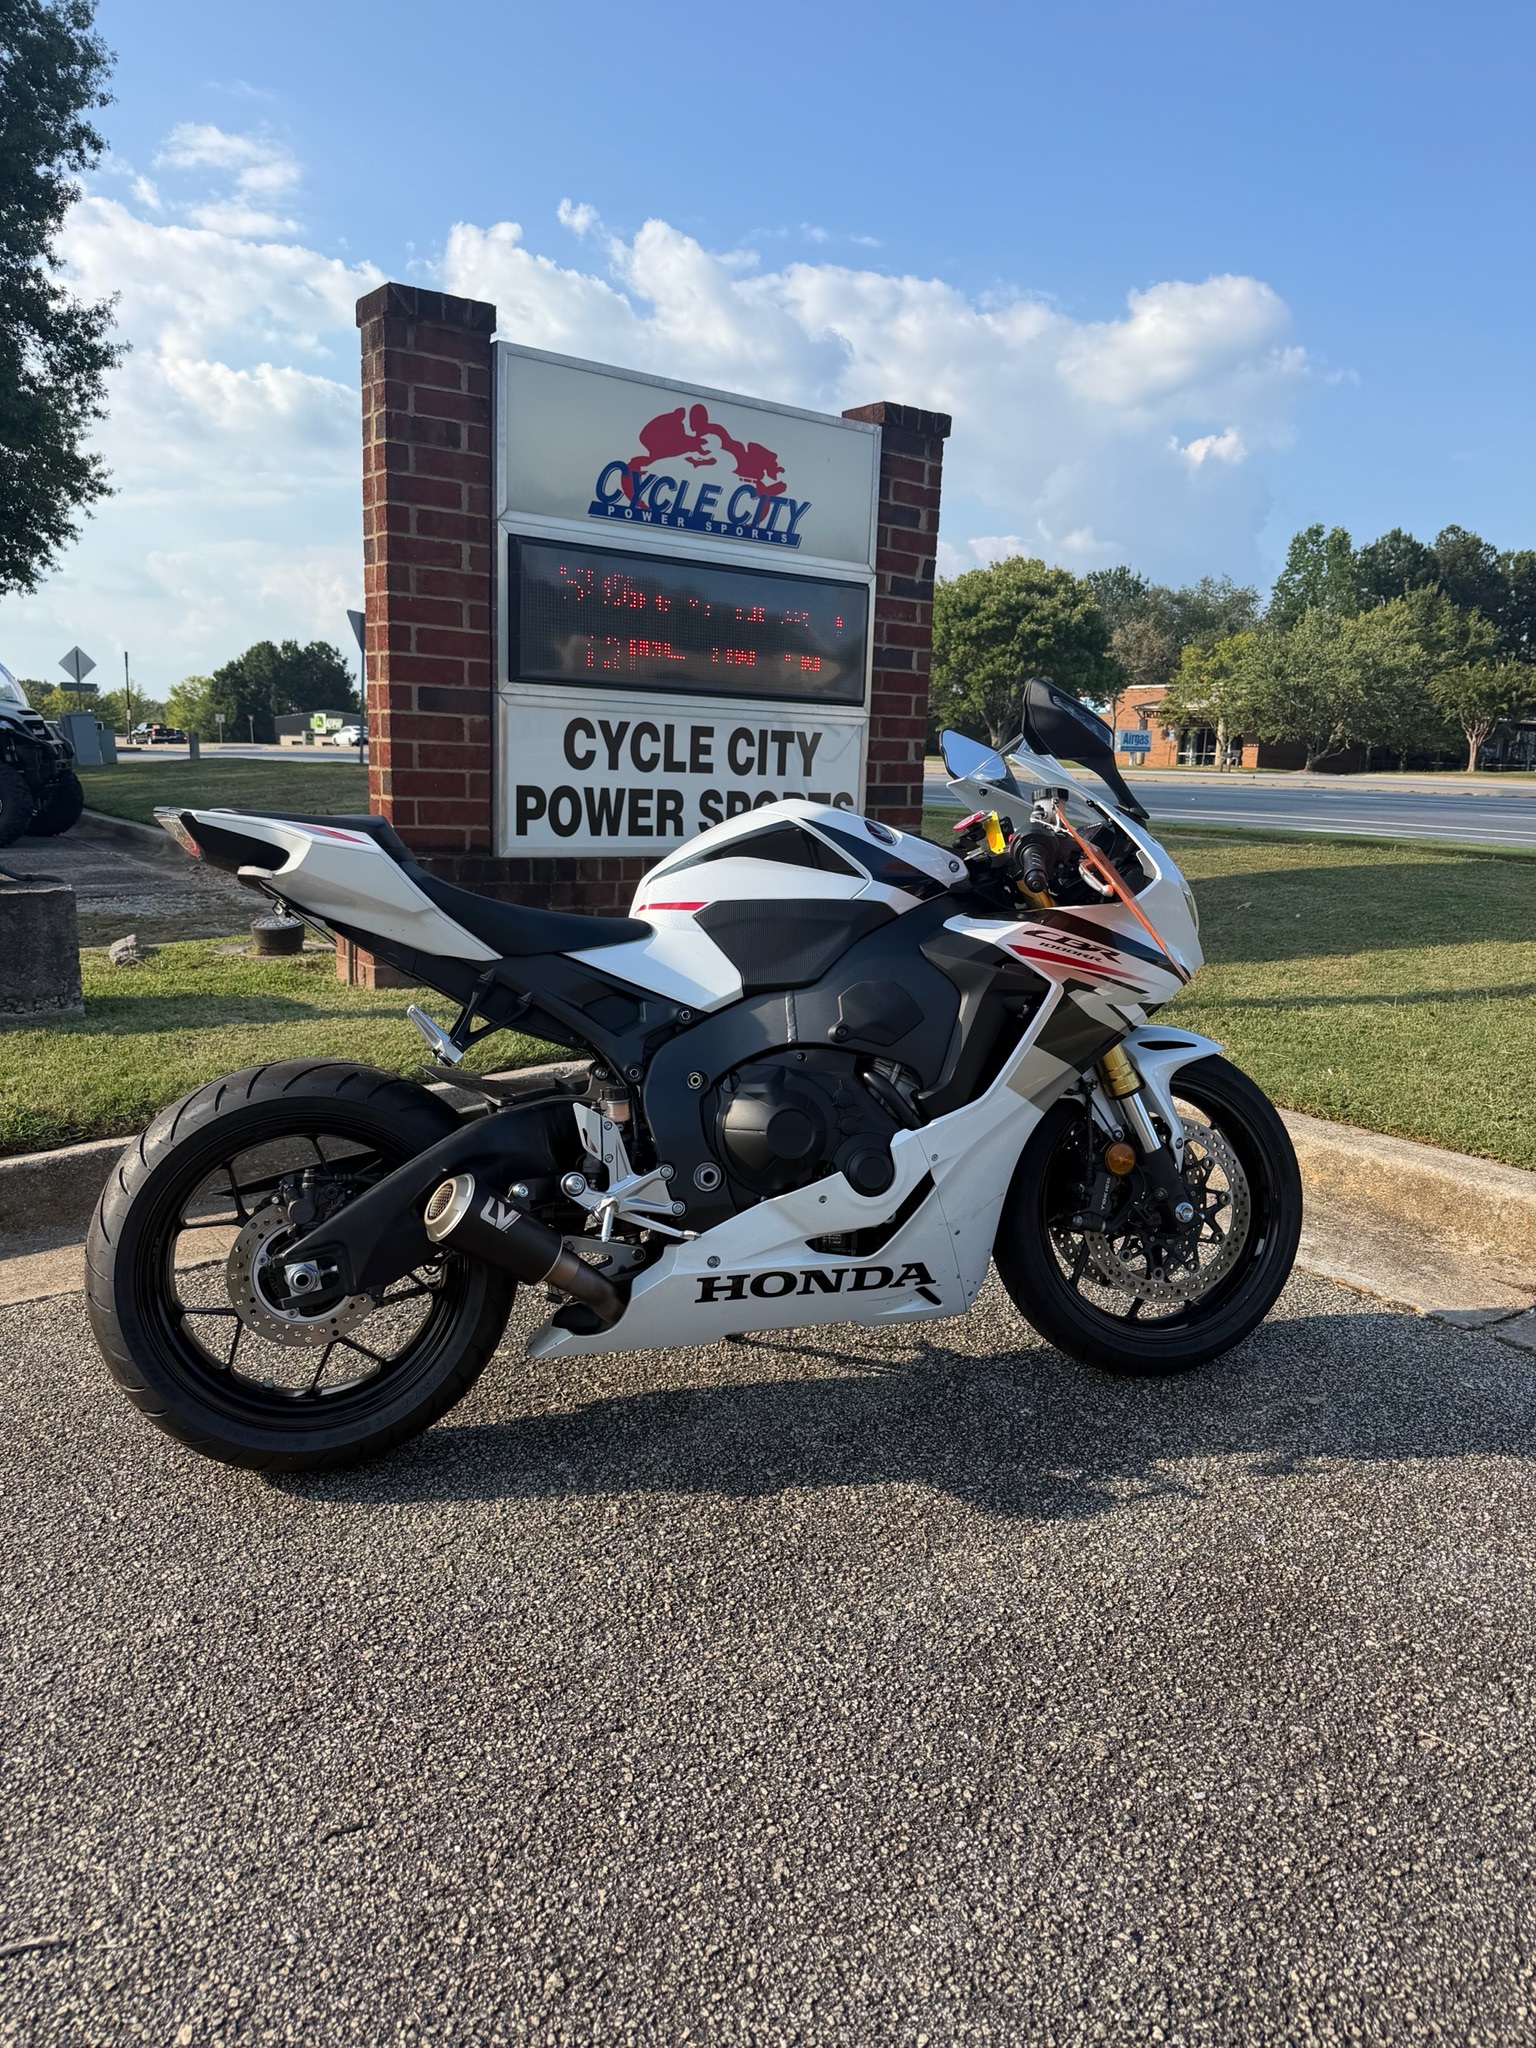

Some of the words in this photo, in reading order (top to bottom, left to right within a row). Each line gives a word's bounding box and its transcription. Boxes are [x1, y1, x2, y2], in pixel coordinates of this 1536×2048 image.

[596, 461, 722, 517] CYCLE
[727, 484, 812, 534] CITY
[607, 505, 685, 527] POWER
[705, 521, 788, 543] SPORTS
[563, 717, 715, 774] CYCLE
[727, 727, 823, 777] CITY
[1122, 732, 1150, 746] Airgas
[515, 785, 685, 838] POWER
[1023, 930, 1122, 965] CBR
[1039, 942, 1103, 963] 1000RR
[694, 1261, 937, 1303] HONDA
